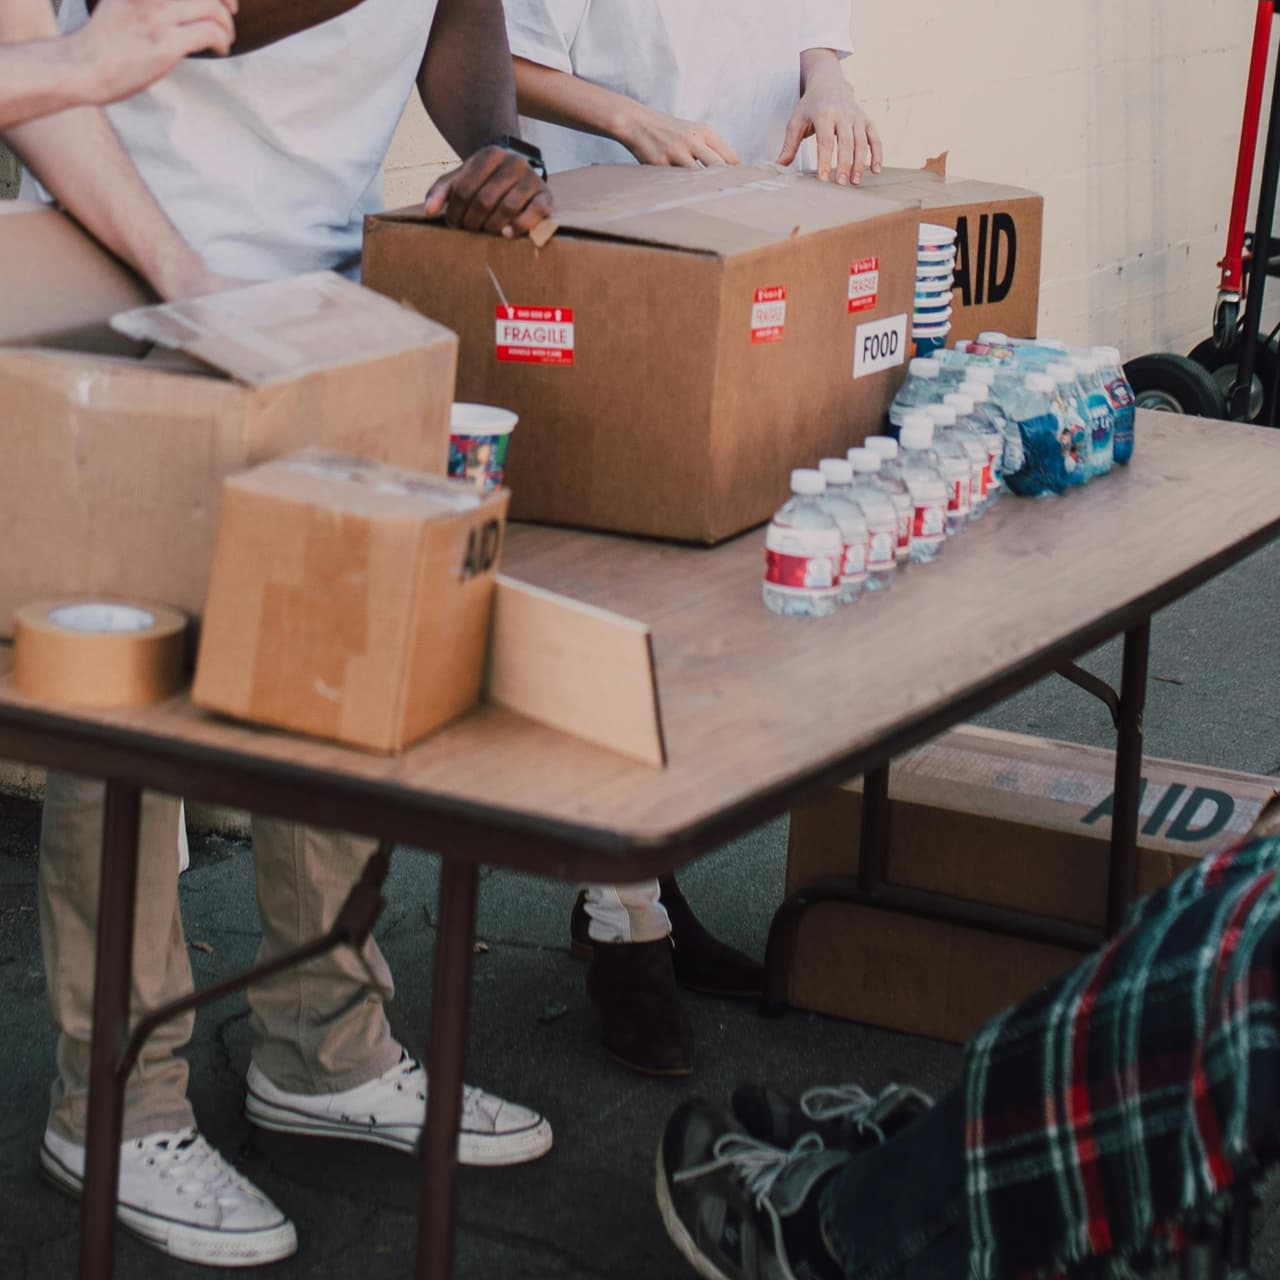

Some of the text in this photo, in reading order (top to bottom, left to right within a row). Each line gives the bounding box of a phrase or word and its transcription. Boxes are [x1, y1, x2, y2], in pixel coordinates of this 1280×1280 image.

[951, 212, 1017, 307] AID
[503, 326, 568, 345] FRAGILE
[863, 329, 899, 363] FOOD
